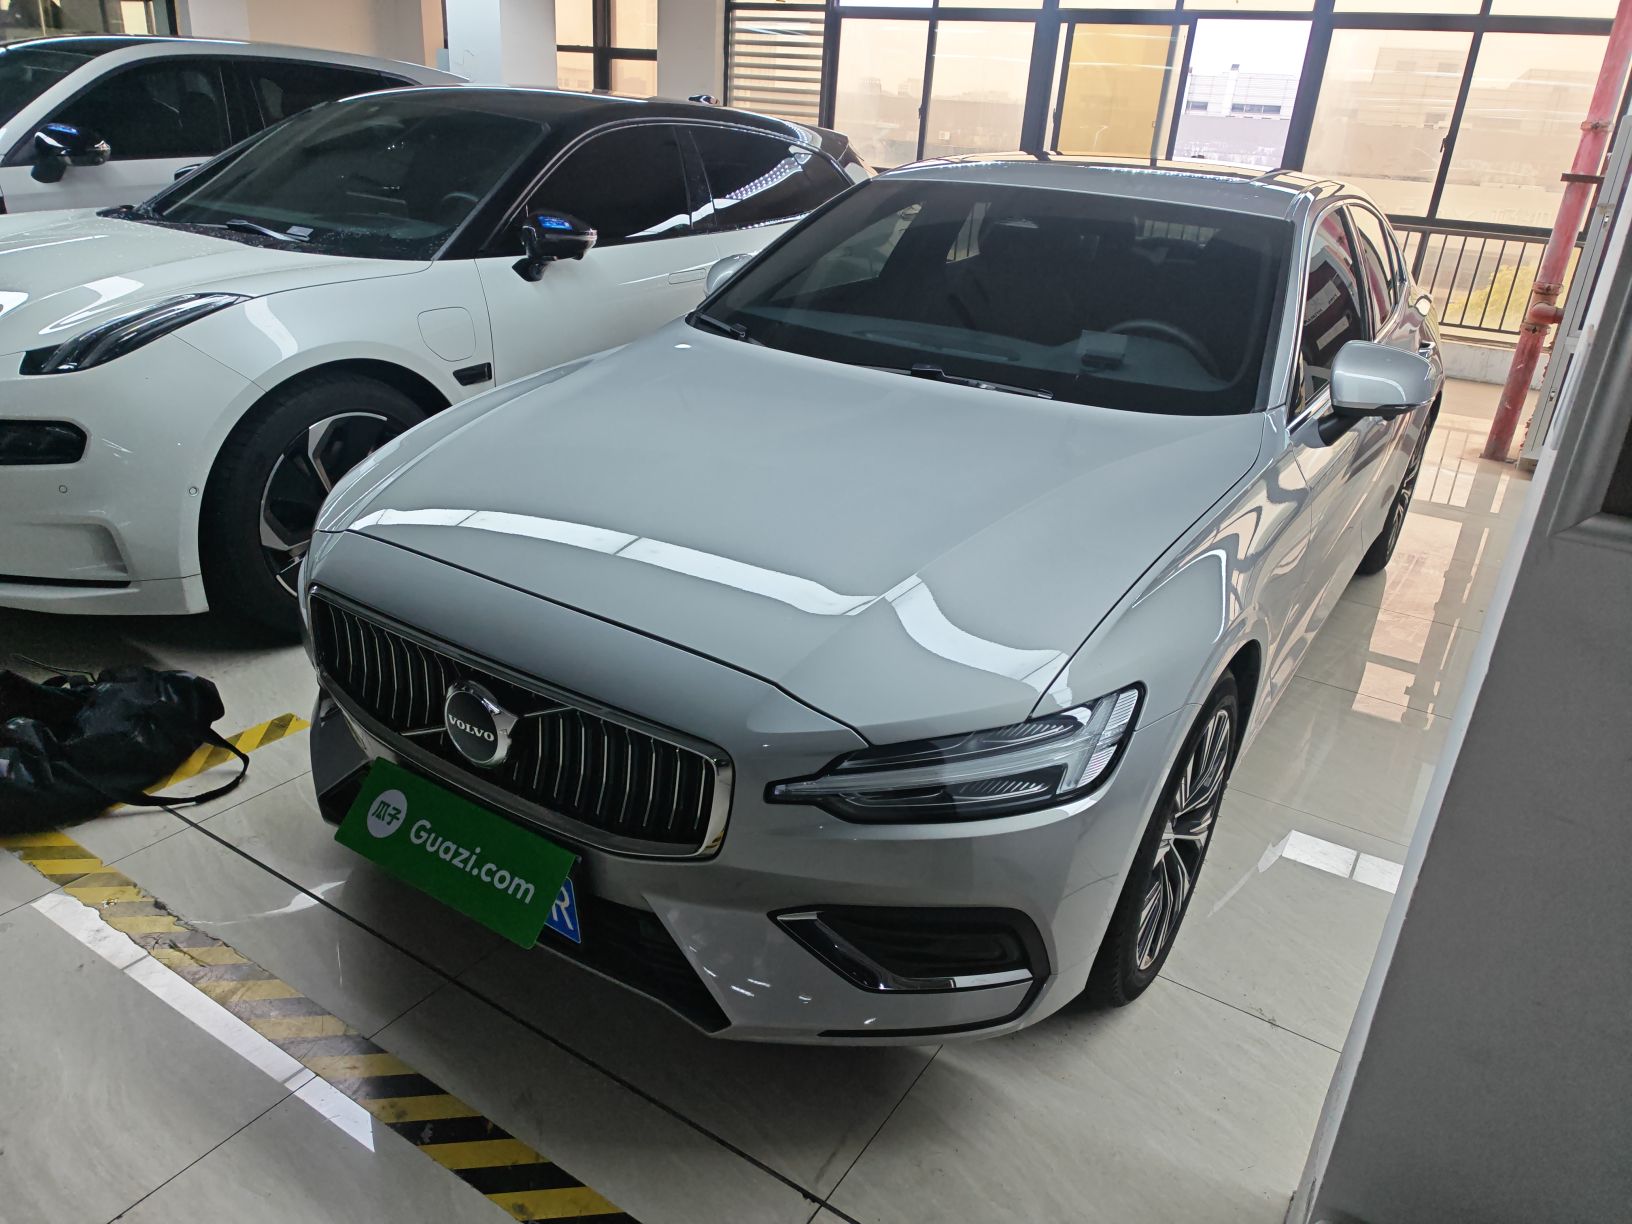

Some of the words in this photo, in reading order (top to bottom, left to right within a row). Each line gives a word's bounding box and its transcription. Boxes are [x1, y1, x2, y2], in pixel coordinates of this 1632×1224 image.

[447, 713, 495, 742] VOLVO
[371, 801, 401, 826] 瓜子
[409, 819, 536, 904] Guazi.com
[552, 886, 574, 931] R
